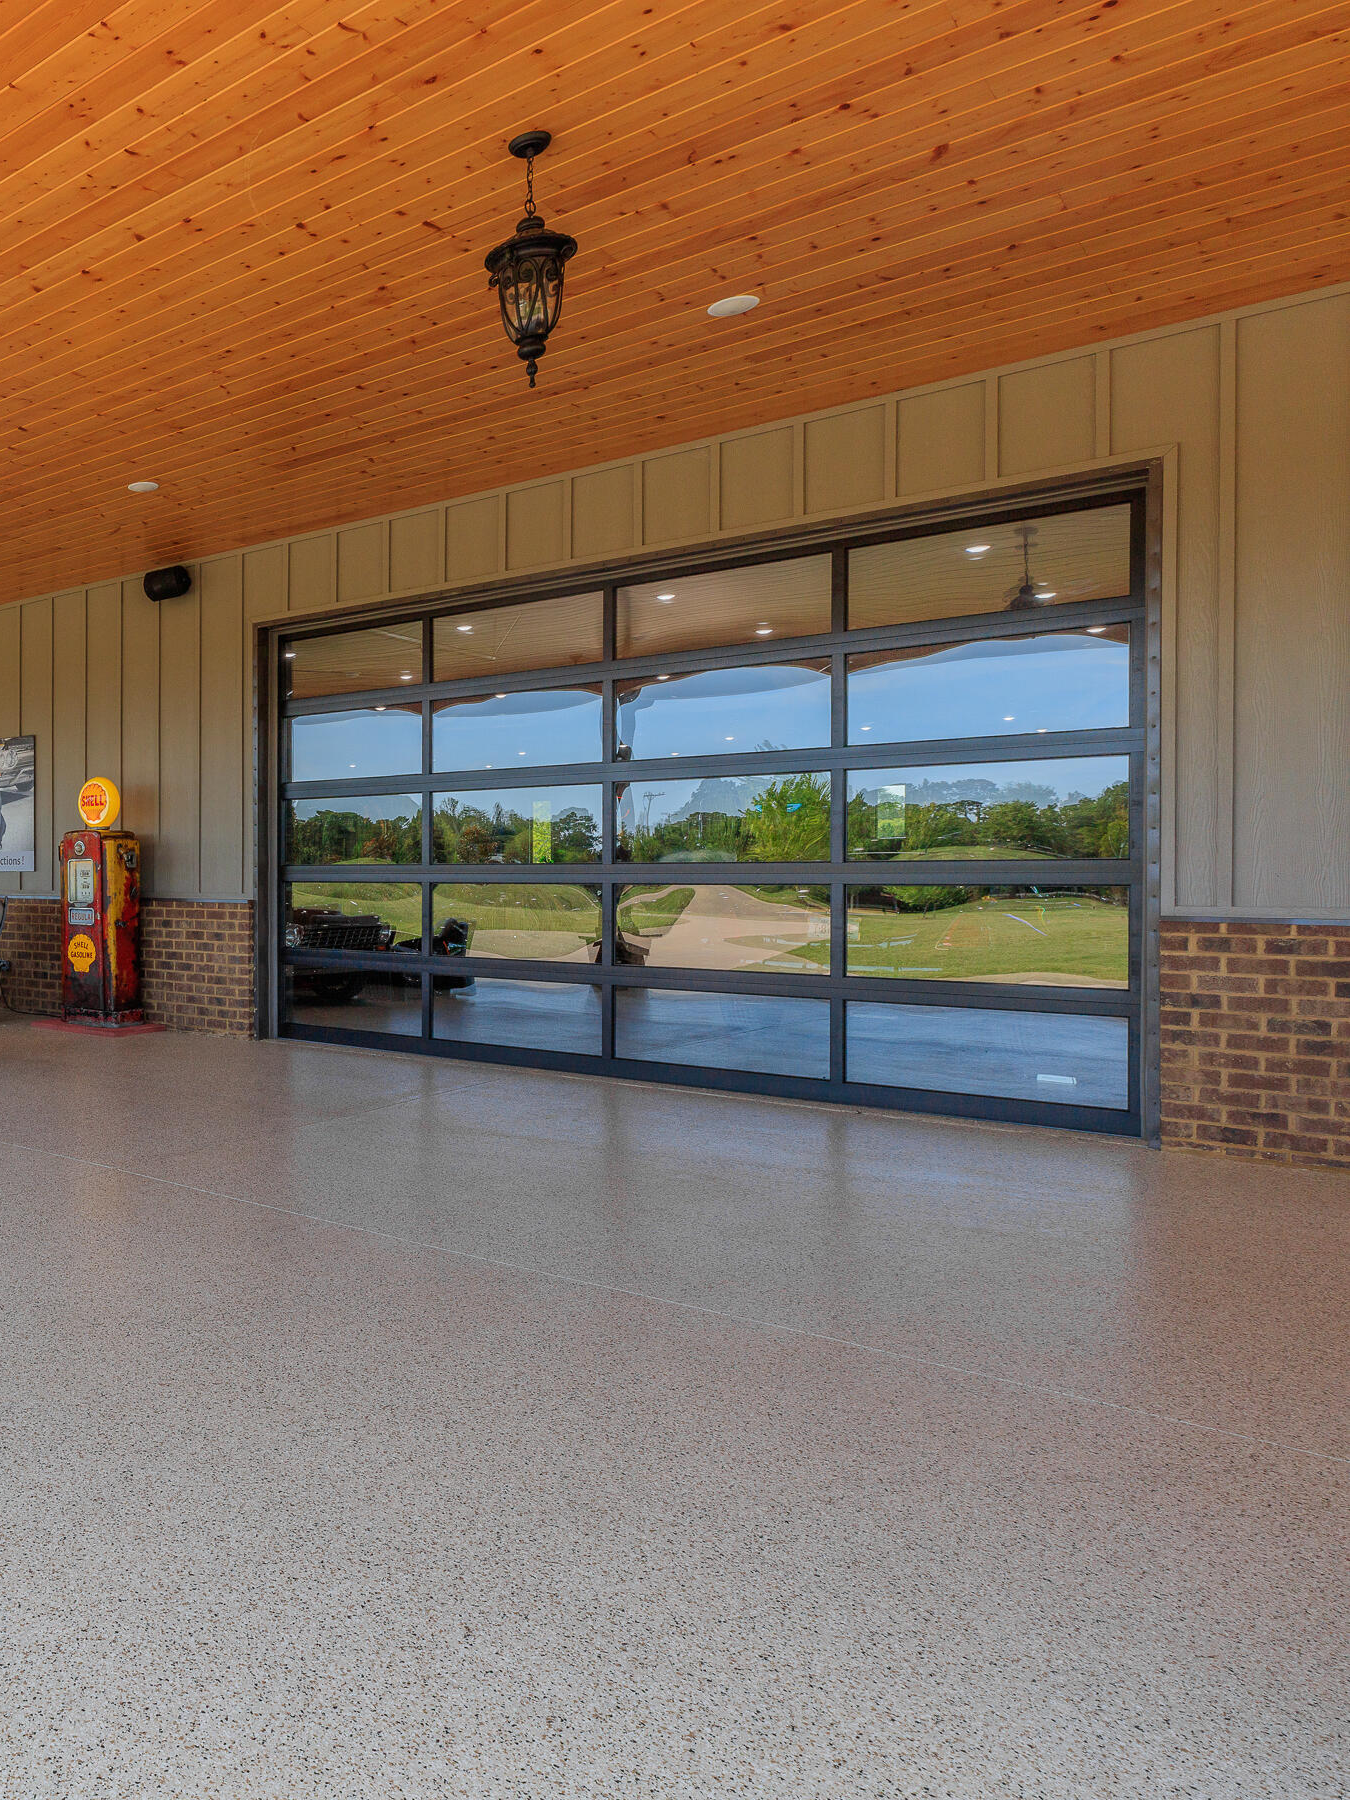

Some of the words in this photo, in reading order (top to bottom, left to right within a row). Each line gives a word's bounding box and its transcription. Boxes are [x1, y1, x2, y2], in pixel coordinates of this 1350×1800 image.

[81, 795, 105, 807] SHELL
[73, 941, 89, 950] SHELL
[70, 951, 93, 959] GASOLINE
